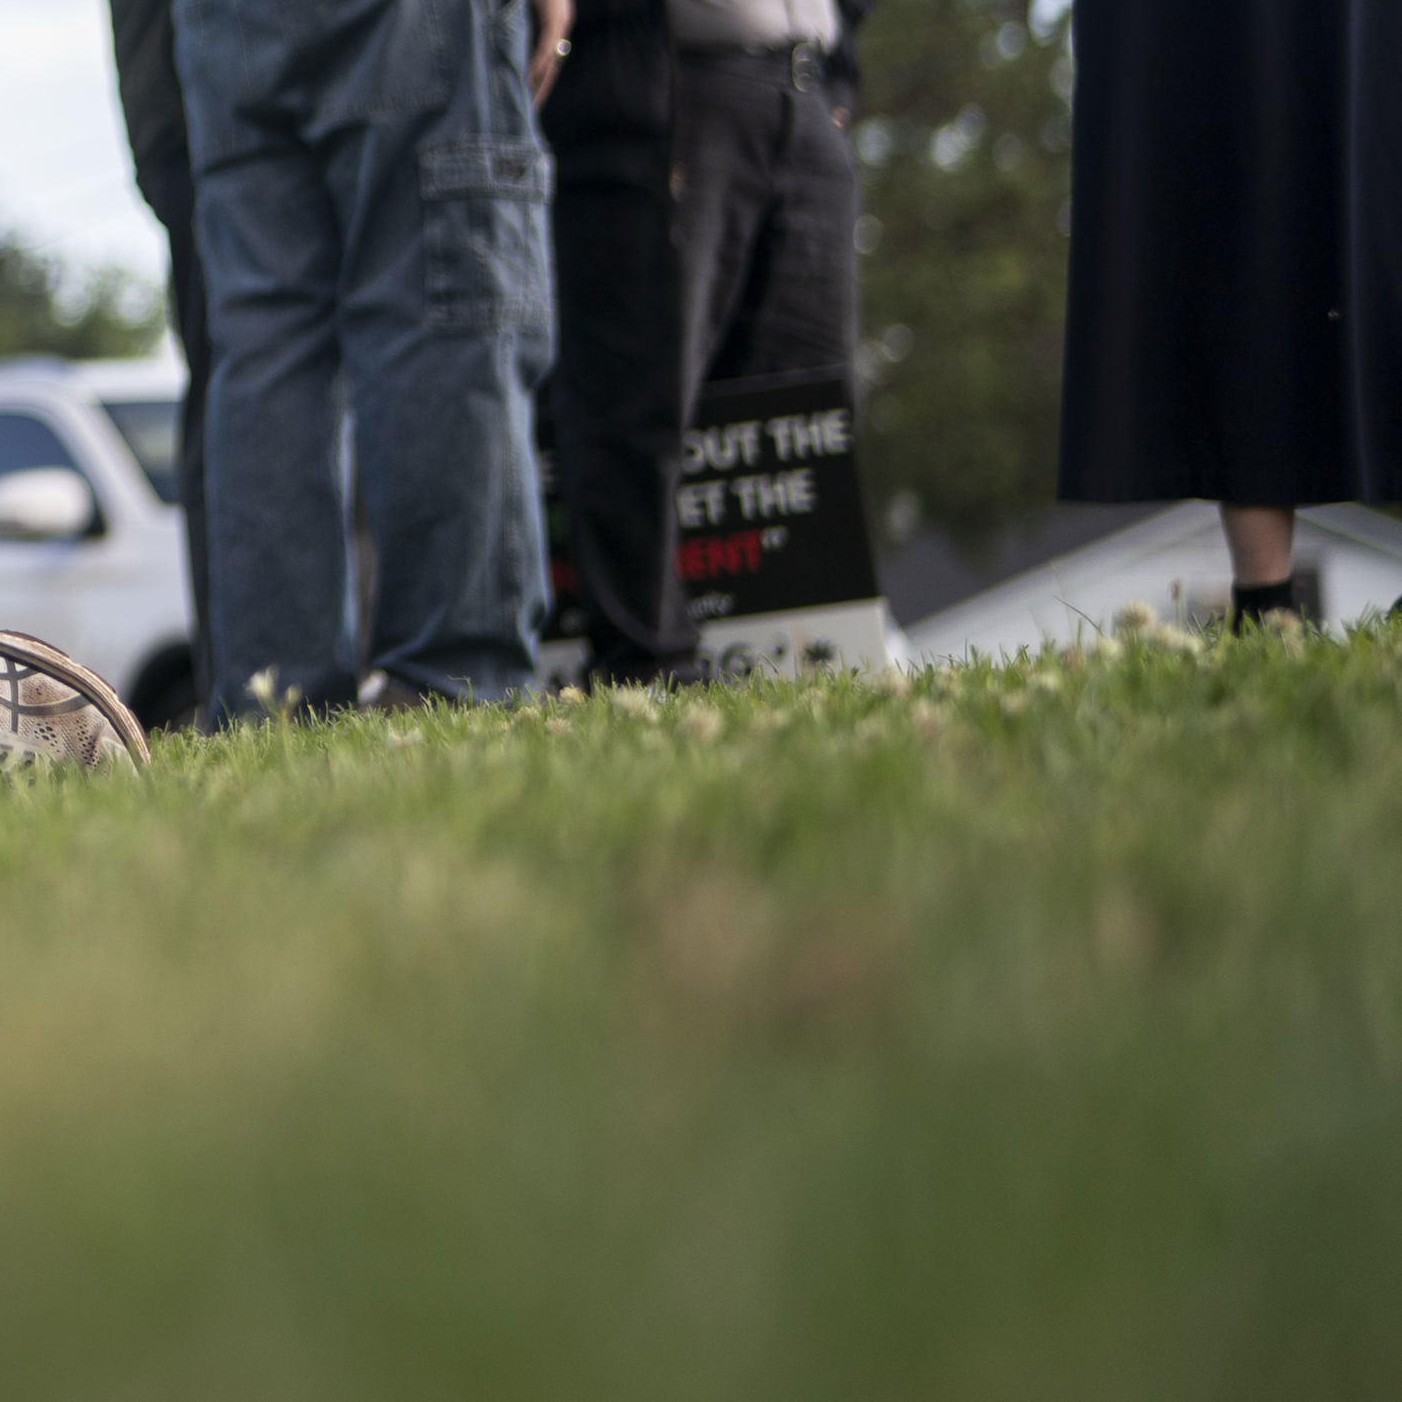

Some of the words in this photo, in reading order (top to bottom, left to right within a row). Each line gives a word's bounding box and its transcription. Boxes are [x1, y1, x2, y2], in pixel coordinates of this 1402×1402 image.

[767, 409, 852, 462] THE
[677, 479, 726, 528] ET
[731, 469, 816, 519] THE
